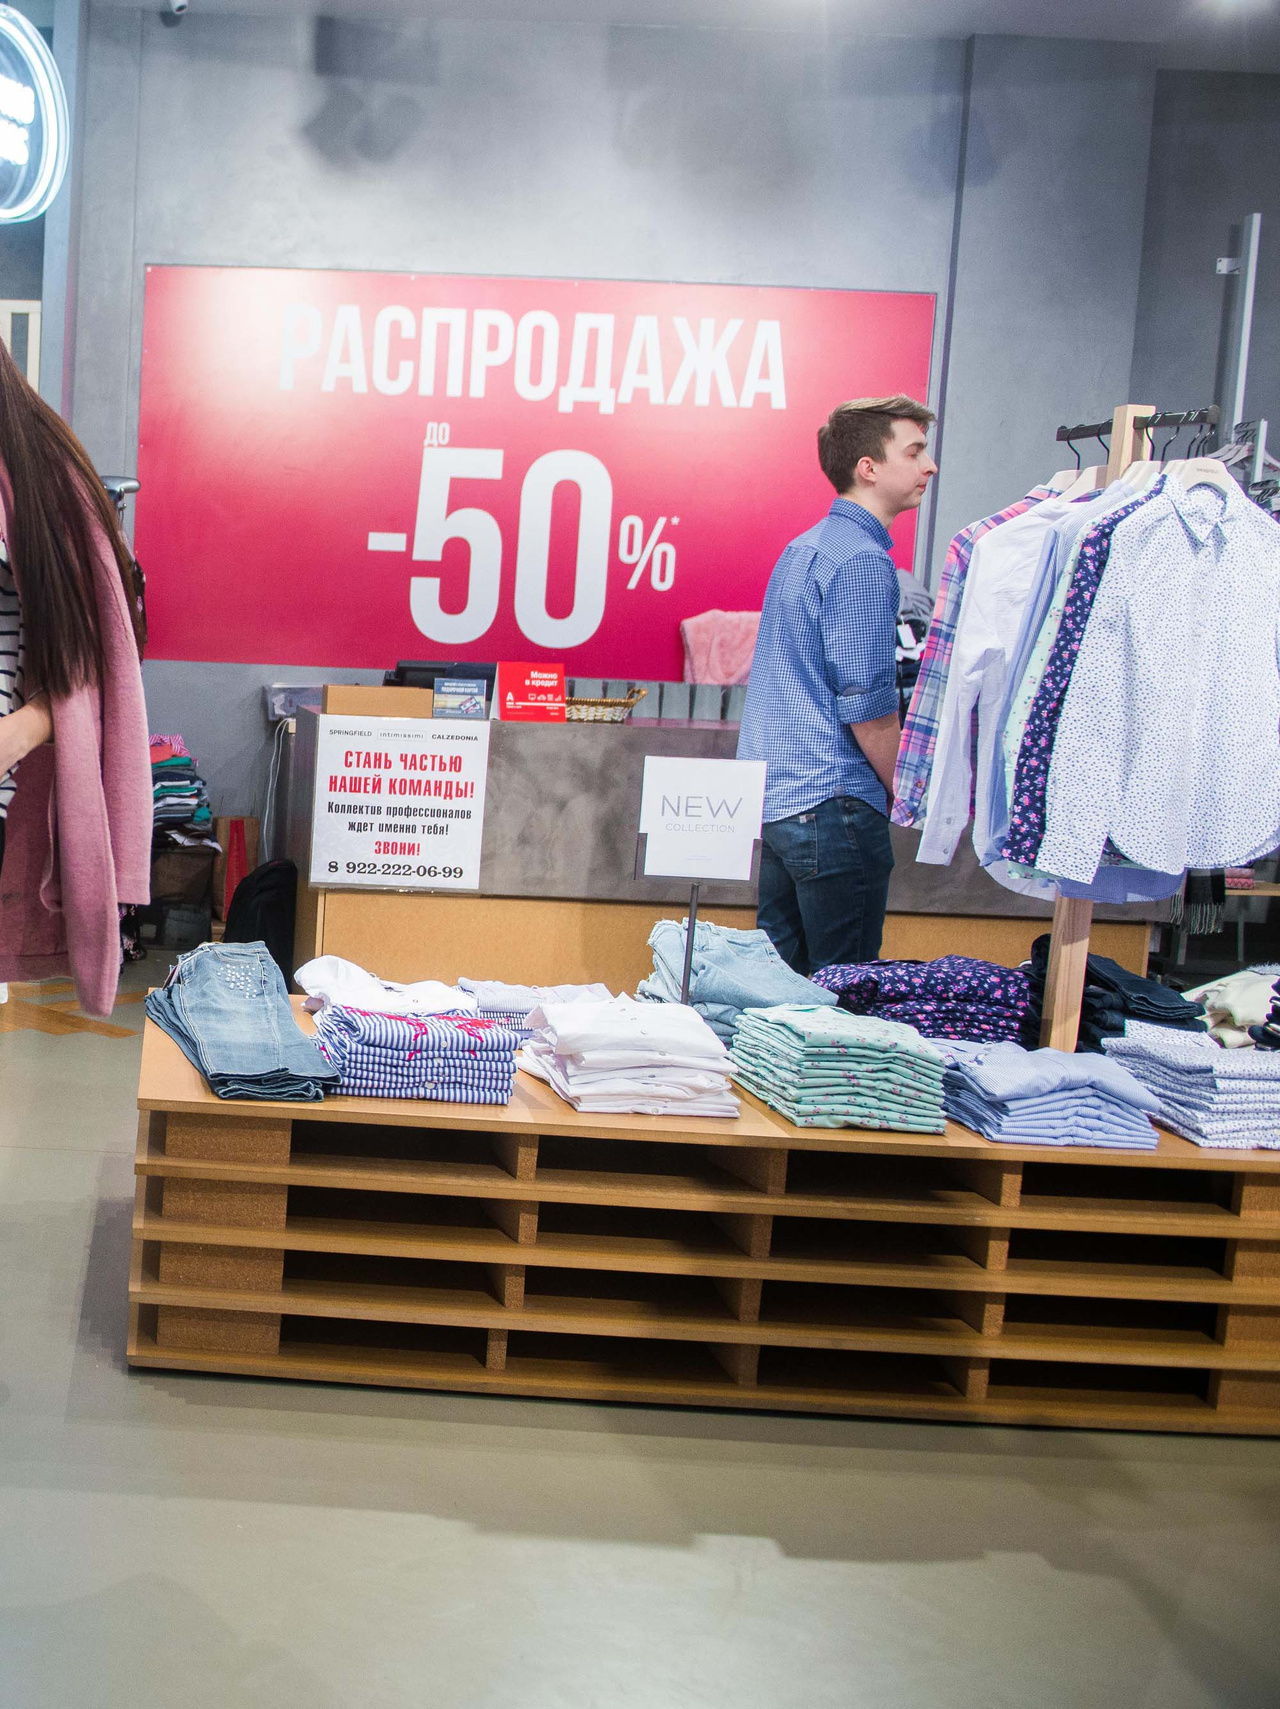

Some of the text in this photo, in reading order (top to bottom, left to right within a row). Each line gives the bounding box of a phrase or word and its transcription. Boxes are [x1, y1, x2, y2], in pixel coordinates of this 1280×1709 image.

[280, 303, 786, 414] РАСПРОДАЖА
[424, 421, 450, 448] ДО
[530, 671, 558, 680] Можно
[531, 680, 558, 688] кредит
[329, 729, 372, 737] SPRINGFIELD
[431, 733, 479, 741] CALZEDONIA
[344, 750, 463, 773] СТАНЬ ЧАСТЬЮ
[328, 774, 475, 800] НАШЕЙ КОМАНДЫ!
[327, 801, 472, 820] Коллектив профессионалов
[661, 795, 743, 819] NEW
[348, 821, 449, 836] ждет именно тебя!
[665, 823, 735, 833] COLLECTION
[374, 840, 421, 856] ЗВОНИ!
[327, 860, 464, 879] 8 922-222-06-99
